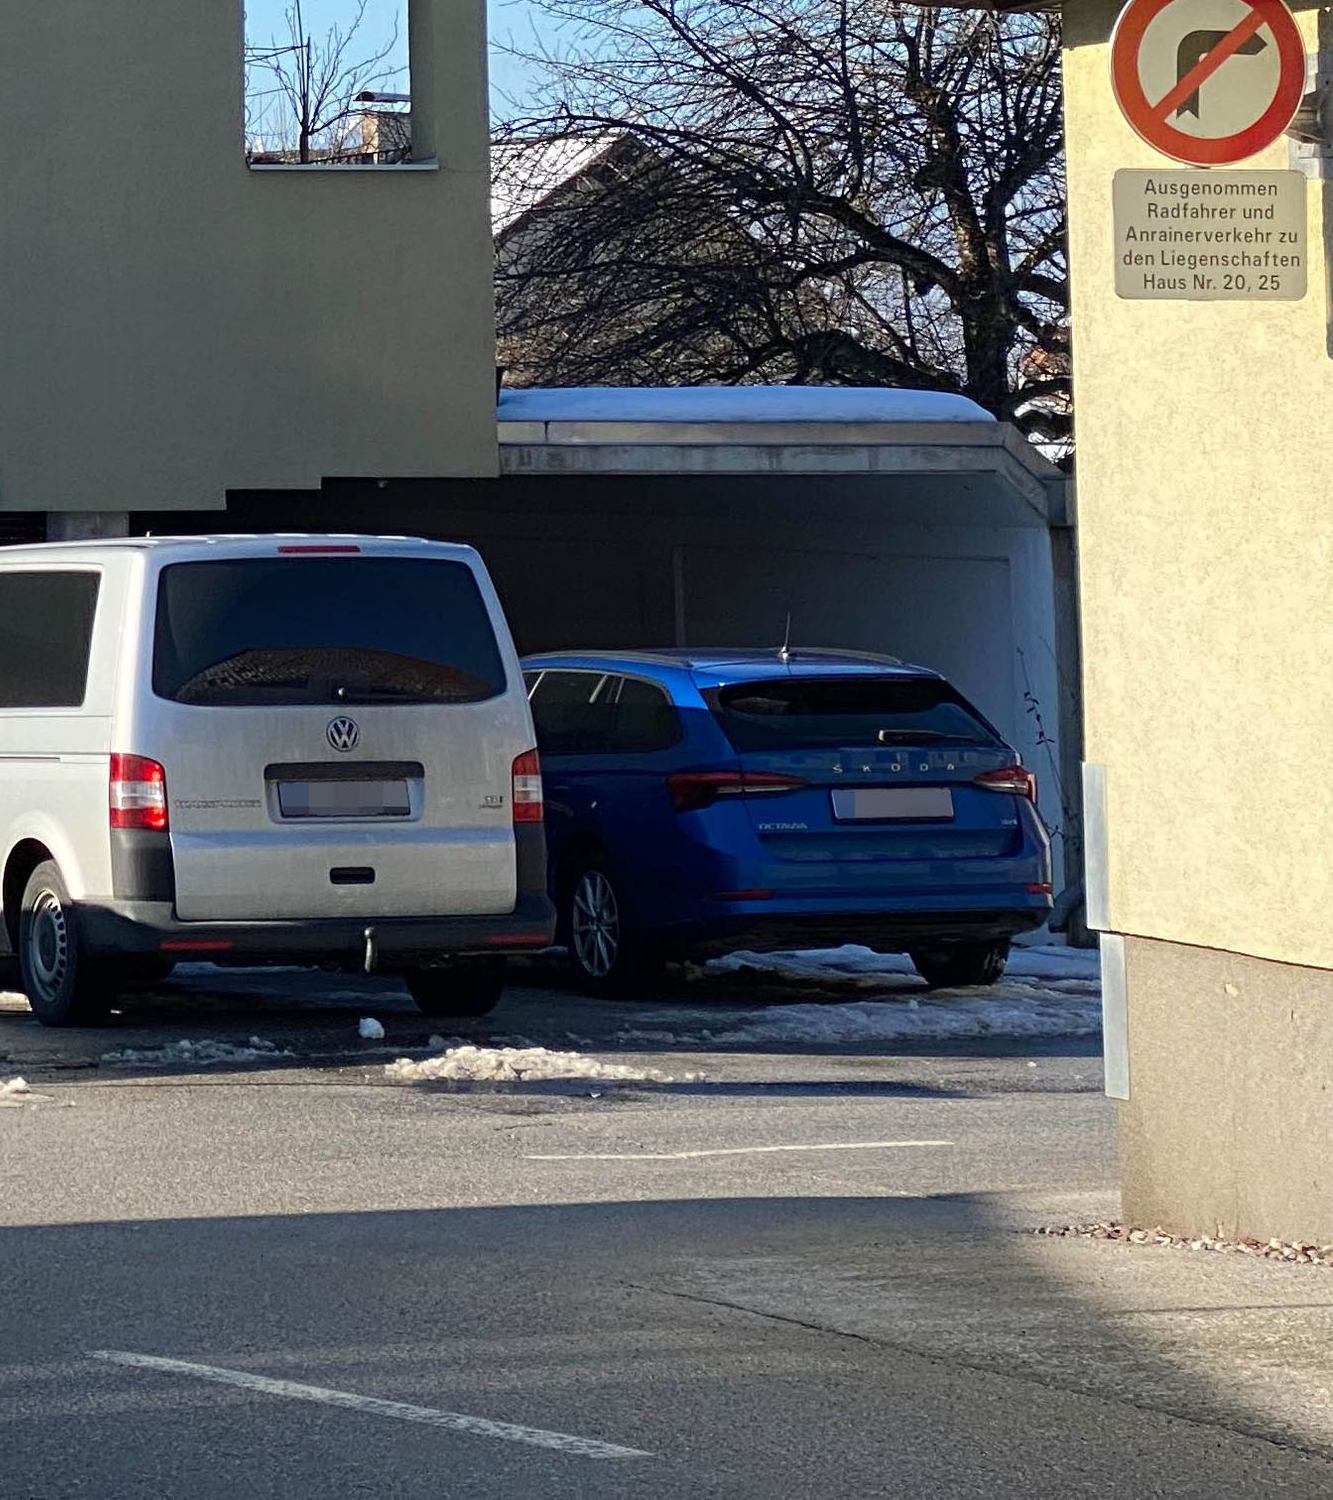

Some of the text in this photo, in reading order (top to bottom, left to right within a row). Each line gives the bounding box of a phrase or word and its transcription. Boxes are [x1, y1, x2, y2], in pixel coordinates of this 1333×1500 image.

[1144, 179, 1278, 199] Ausgenommen
[1147, 202, 1275, 220] Radfahrer und
[1125, 226, 1298, 243] Anrainerverkehr zu
[1122, 250, 1301, 270] den Liegenschaften
[1143, 273, 1281, 292] Haus Nr. 20, 25
